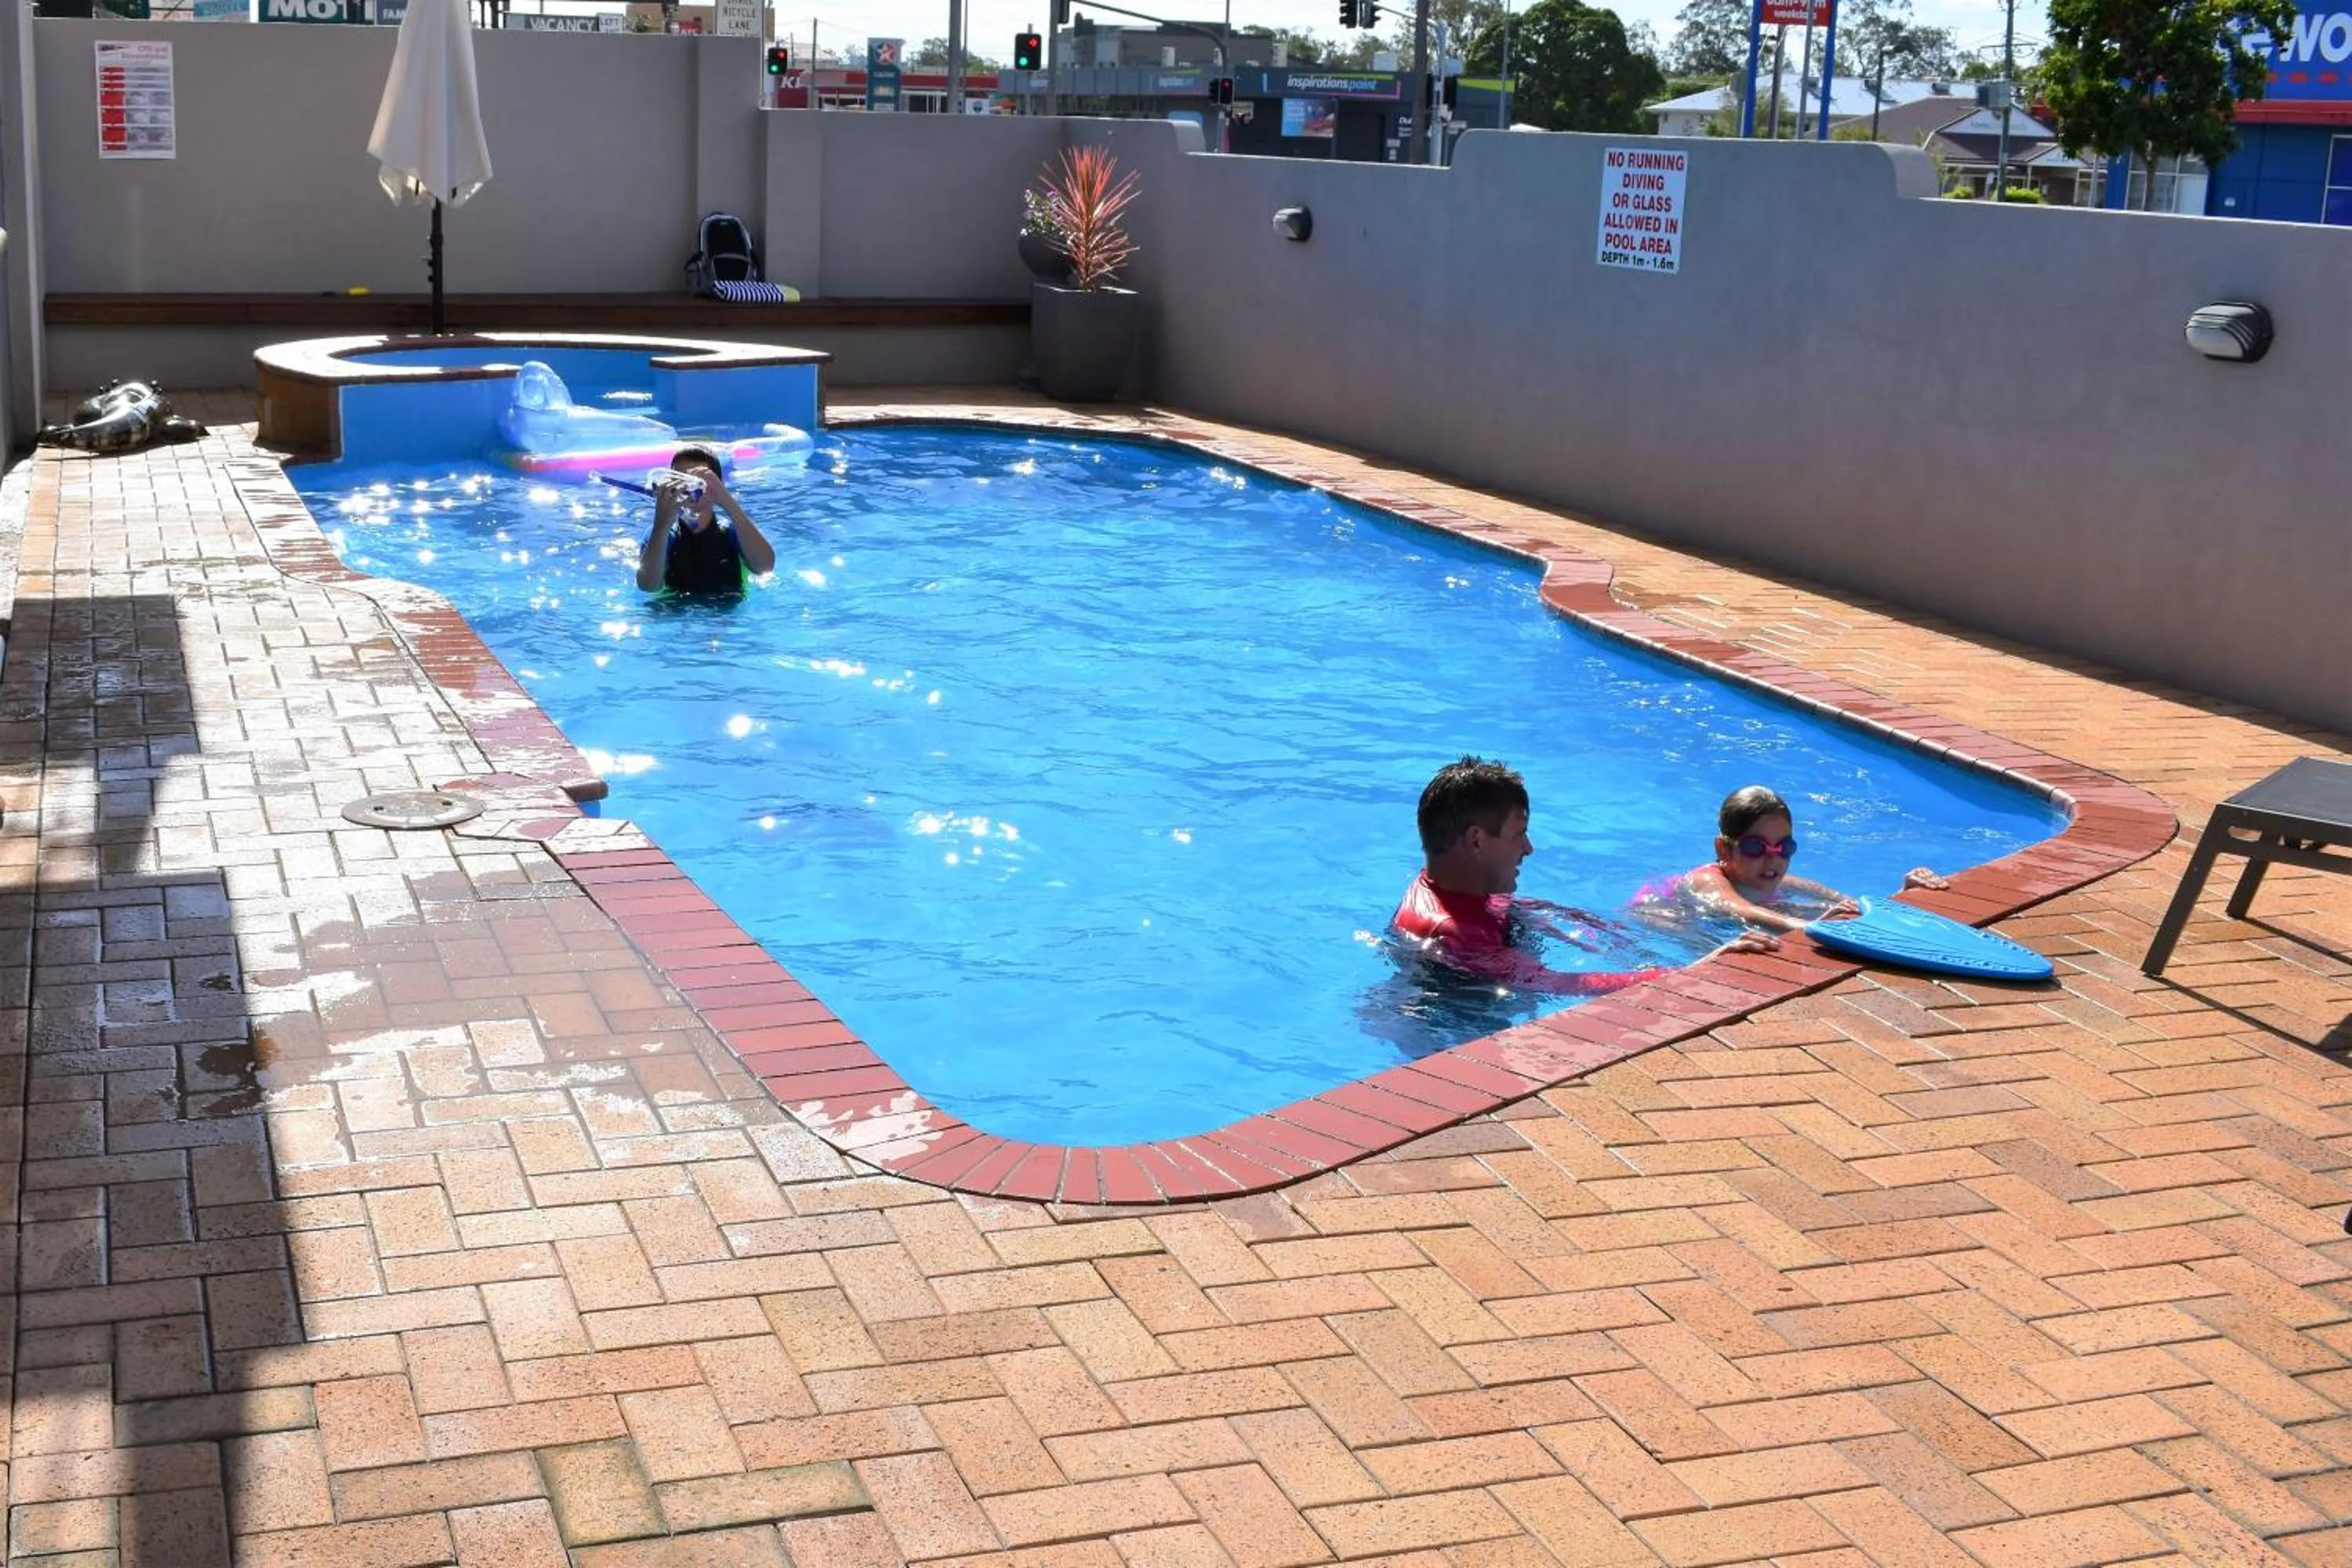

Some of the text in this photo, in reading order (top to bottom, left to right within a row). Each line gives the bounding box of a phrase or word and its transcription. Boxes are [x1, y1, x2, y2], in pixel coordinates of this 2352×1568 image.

[529, 16, 596, 32] VACANCY
[728, 20, 750, 30] LANE
[1608, 151, 1684, 171] NO RUNNING
[1622, 173, 1664, 191] DIVING
[1613, 193, 1671, 212] OR GLASS
[1604, 213, 1678, 234] ALLOWED IN
[1605, 234, 1672, 255] POOL AREA
[1602, 251, 1630, 264] DEPTH
[1633, 255, 1644, 267] 1m
[1653, 257, 1675, 270] 1.6m
